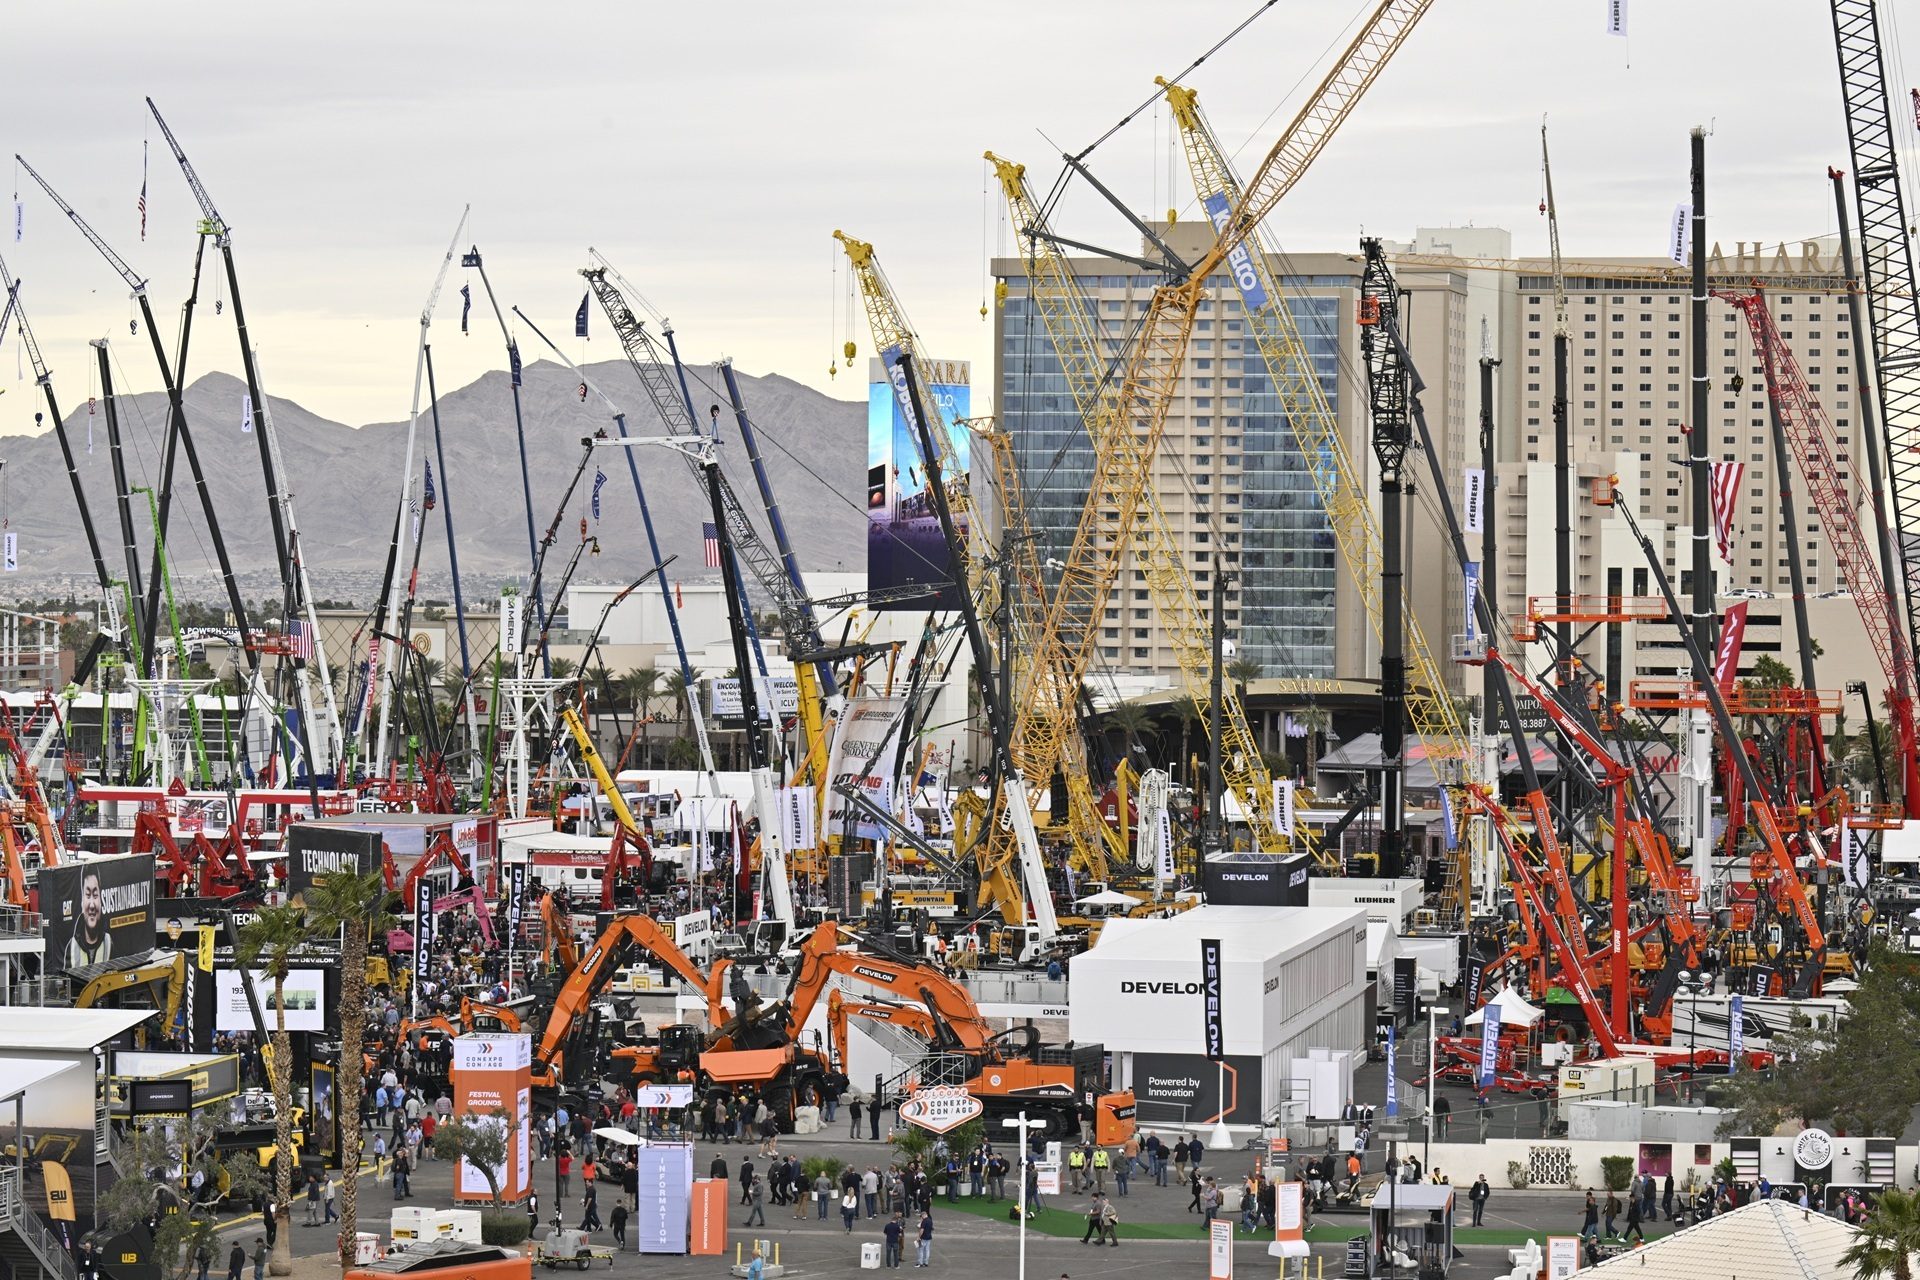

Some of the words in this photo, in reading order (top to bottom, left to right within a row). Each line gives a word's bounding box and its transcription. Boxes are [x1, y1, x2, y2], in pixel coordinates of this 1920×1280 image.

[1690, 241, 1847, 273] AHARA
[1717, 612, 1738, 681] ANY
[1279, 680, 1343, 692] SAHARA
[1222, 873, 1269, 881] DEVELON
[1289, 868, 1306, 887] DEVELON
[101, 881, 150, 914] SUSTAINABILITY
[419, 885, 429, 977] DEVELON
[684, 919, 708, 936] DEVELON
[584, 948, 602, 974] DOOSAN
[859, 967, 893, 982] DEVELON
[1264, 976, 1279, 995] DEVELON
[1206, 947, 1218, 1055] DEVELON
[862, 1008, 890, 1018] DEVELON
[1482, 1019, 1498, 1077] TEUPEN
[1148, 1076, 1184, 1087] Powered
[1188, 1077, 1200, 1089] by
[1149, 1086, 1194, 1097] Innovation
[915, 1088, 967, 1098] WELCOME
[1797, 1135, 1809, 1154] WHITE
[1810, 1132, 1828, 1144] CLAW
